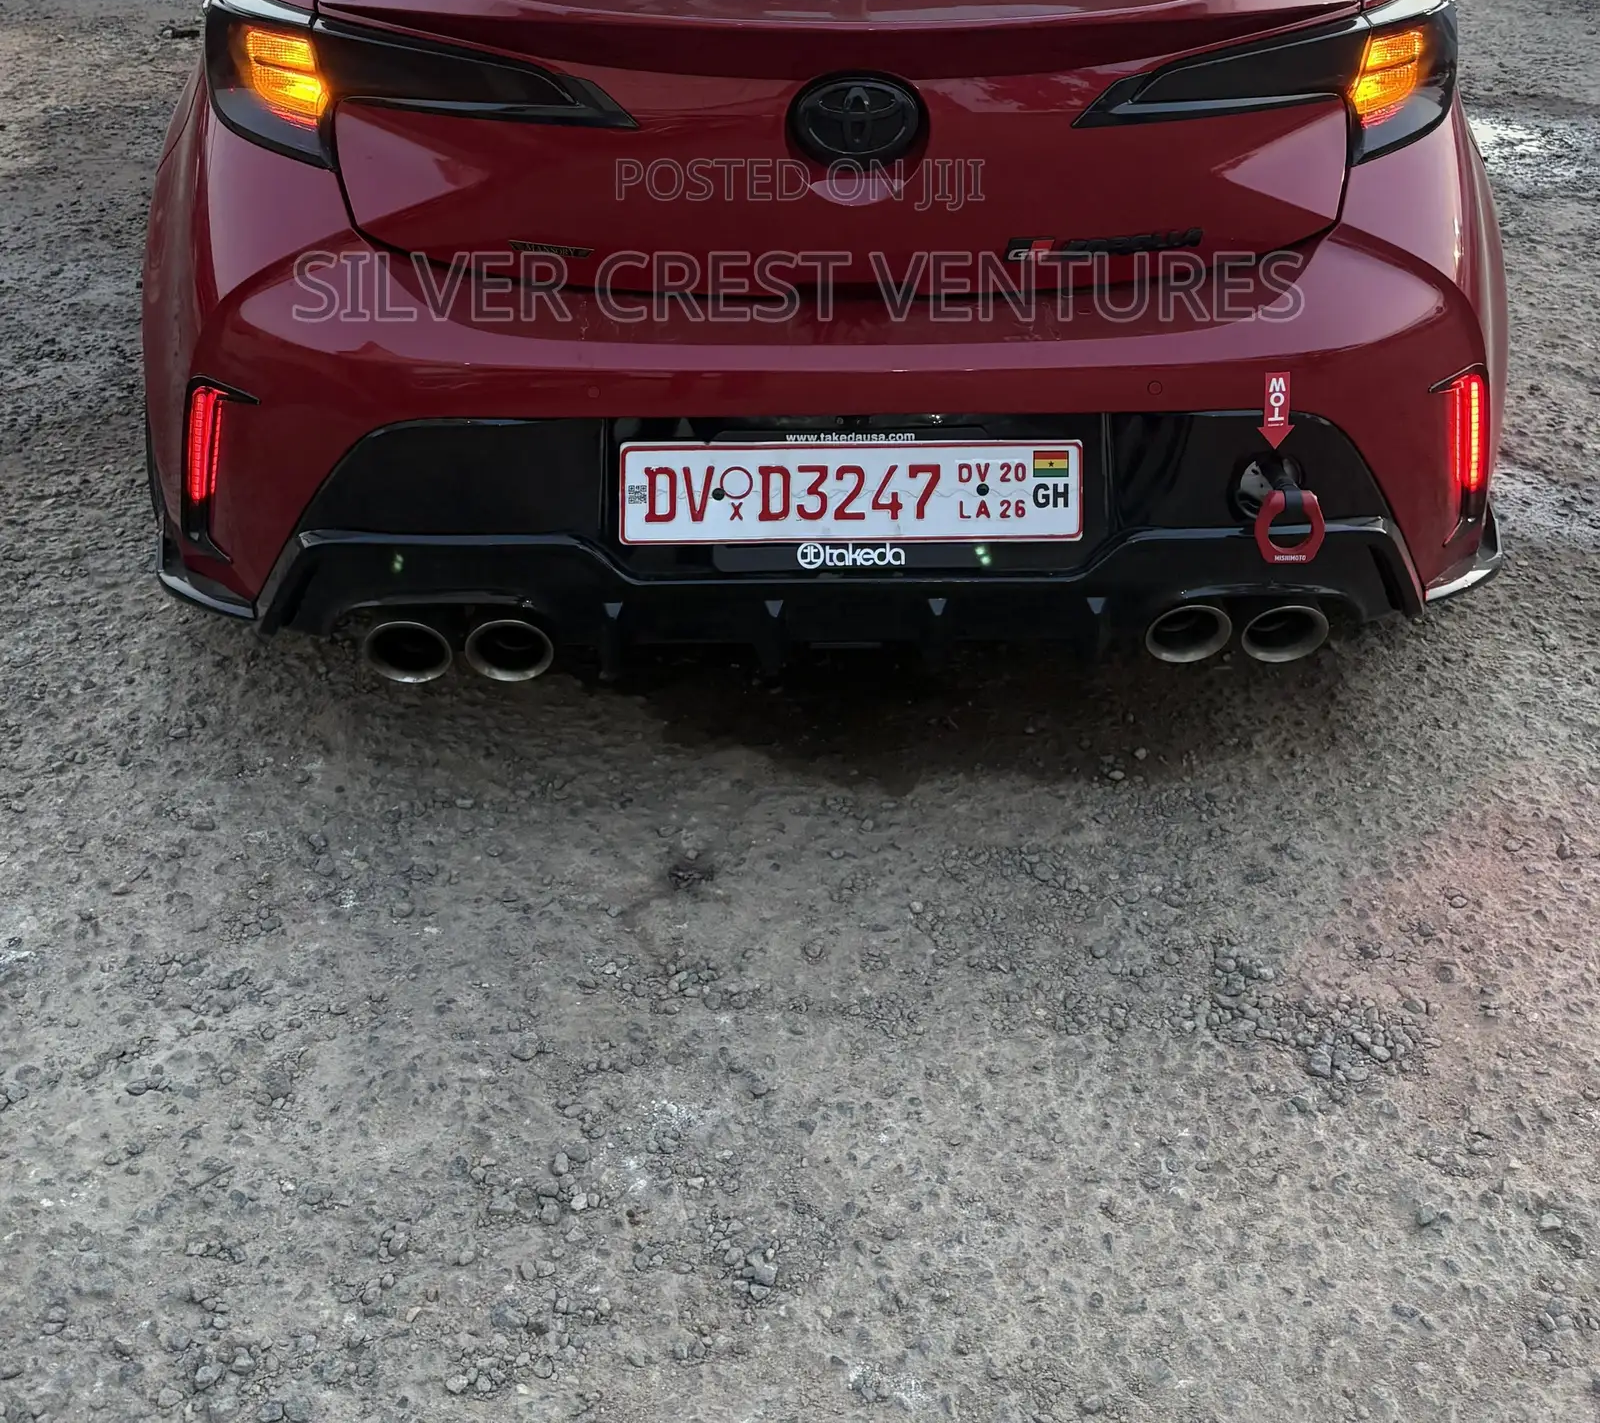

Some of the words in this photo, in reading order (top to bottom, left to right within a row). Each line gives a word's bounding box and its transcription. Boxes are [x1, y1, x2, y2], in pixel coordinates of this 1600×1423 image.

[785, 431, 916, 443] www.takedausa.com
[958, 462, 991, 483] DV
[999, 461, 1027, 483] 20
[643, 465, 715, 523] DV
[757, 463, 942, 523] D3247
[1032, 483, 1070, 509] GH
[958, 500, 991, 519] LA
[999, 499, 1027, 519] 26
[827, 543, 906, 566] takeda
